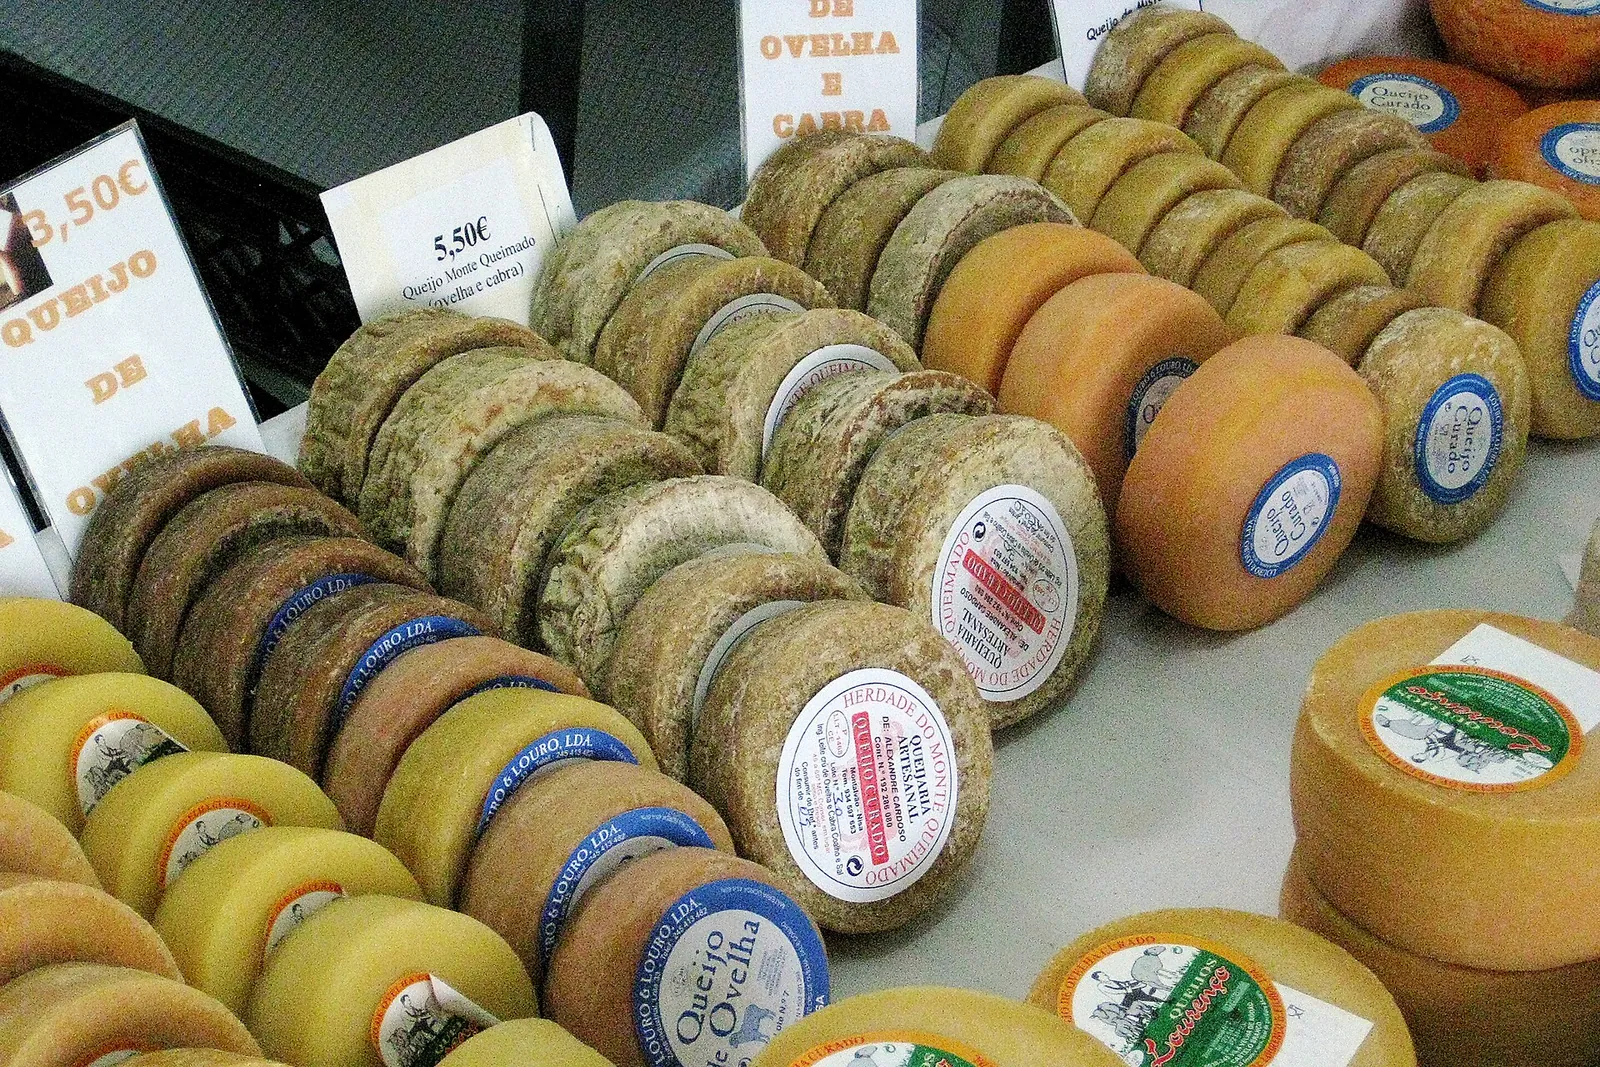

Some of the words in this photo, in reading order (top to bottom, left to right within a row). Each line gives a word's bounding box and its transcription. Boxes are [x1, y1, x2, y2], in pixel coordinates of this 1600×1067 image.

[760, 31, 900, 59] OVELHA
[1087, 18, 1118, 40] Queijo
[822, 73, 842, 95] E
[1372, 87, 1428, 101] Queijo
[1371, 97, 1430, 110] Curado
[772, 109, 890, 138] CABRA
[22, 159, 149, 248] 3,50€
[435, 216, 491, 262] 5,50€
[403, 276, 443, 299] Queijo
[445, 261, 477, 283] Monte
[480, 236, 535, 267] Queimado
[429, 284, 474, 306] (ovelha
[476, 281, 482, 291] e
[486, 261, 523, 287] cabra)
[1, 249, 157, 347] QUEIJO
[84, 354, 148, 404] DE
[1448, 405, 1468, 473] Curado
[1462, 406, 1482, 471] Queijo
[1265, 508, 1289, 556] Queijo
[1281, 491, 1305, 540] Curado
[943, 532, 969, 633] QUEIMADO
[960, 587, 989, 614] CARDOSO
[963, 607, 1010, 656] ARTESANAL
[985, 610, 1018, 642] ALEXANDRE
[360, 632, 405, 677] LOURO,
[406, 622, 435, 639] LDA.
[958, 624, 1002, 669] QUEIJARIA
[1009, 619, 1061, 685] HERDADE
[989, 673, 1009, 686] DO
[843, 688, 917, 717] HERDADE
[1407, 686, 1551, 752] Lourenço
[882, 716, 890, 732] DE:
[916, 712, 935, 739] DO
[504, 776, 512, 787] &
[511, 738, 562, 777] LOURO,
[565, 734, 592, 748] LDA.
[817, 737, 826, 755] Leite
[874, 737, 882, 758] Cont.
[793, 767, 801, 777] do
[801, 761, 812, 795] Consumir
[821, 768, 829, 778] de
[829, 762, 837, 776] Lote
[884, 737, 899, 793] ALEXANDRE
[898, 736, 919, 824] ARTESANAL
[909, 735, 931, 816] QUEIJARIA
[930, 743, 947, 814] MONTE
[795, 777, 803, 790] fim
[796, 790, 804, 801] de
[822, 778, 833, 803] Ovelha
[843, 788, 851, 802] 934
[848, 766, 860, 806] Montalvão
[856, 813, 864, 831] Nisa
[853, 717, 874, 781] QUEIJO
[864, 785, 886, 857] CURADO
[879, 778, 888, 793] 192
[805, 797, 813, 807] de
[882, 795, 890, 810] 286
[893, 793, 906, 842] CARDOSO
[827, 810, 837, 831] Cabra
[885, 812, 893, 828] 080
[811, 829, 819, 849] antes
[830, 832, 841, 857] Coalho
[865, 817, 939, 885] QUEIMADO
[548, 908, 558, 918] &
[553, 849, 592, 903] LOURO,
[591, 824, 621, 848] LDA.
[835, 863, 844, 875] Sal
[671, 896, 702, 925] LDA.
[671, 925, 685, 939] 245
[682, 914, 696, 927] 413
[693, 906, 708, 918] 482
[641, 925, 674, 983] LOURO,
[639, 986, 649, 998] &
[677, 930, 727, 1045] Queijo
[709, 920, 760, 1038] Ovelha
[1168, 957, 1217, 1020] QUEIJOS
[1144, 963, 1231, 1067] Lourenço
[639, 1003, 665, 1065] LOURO
